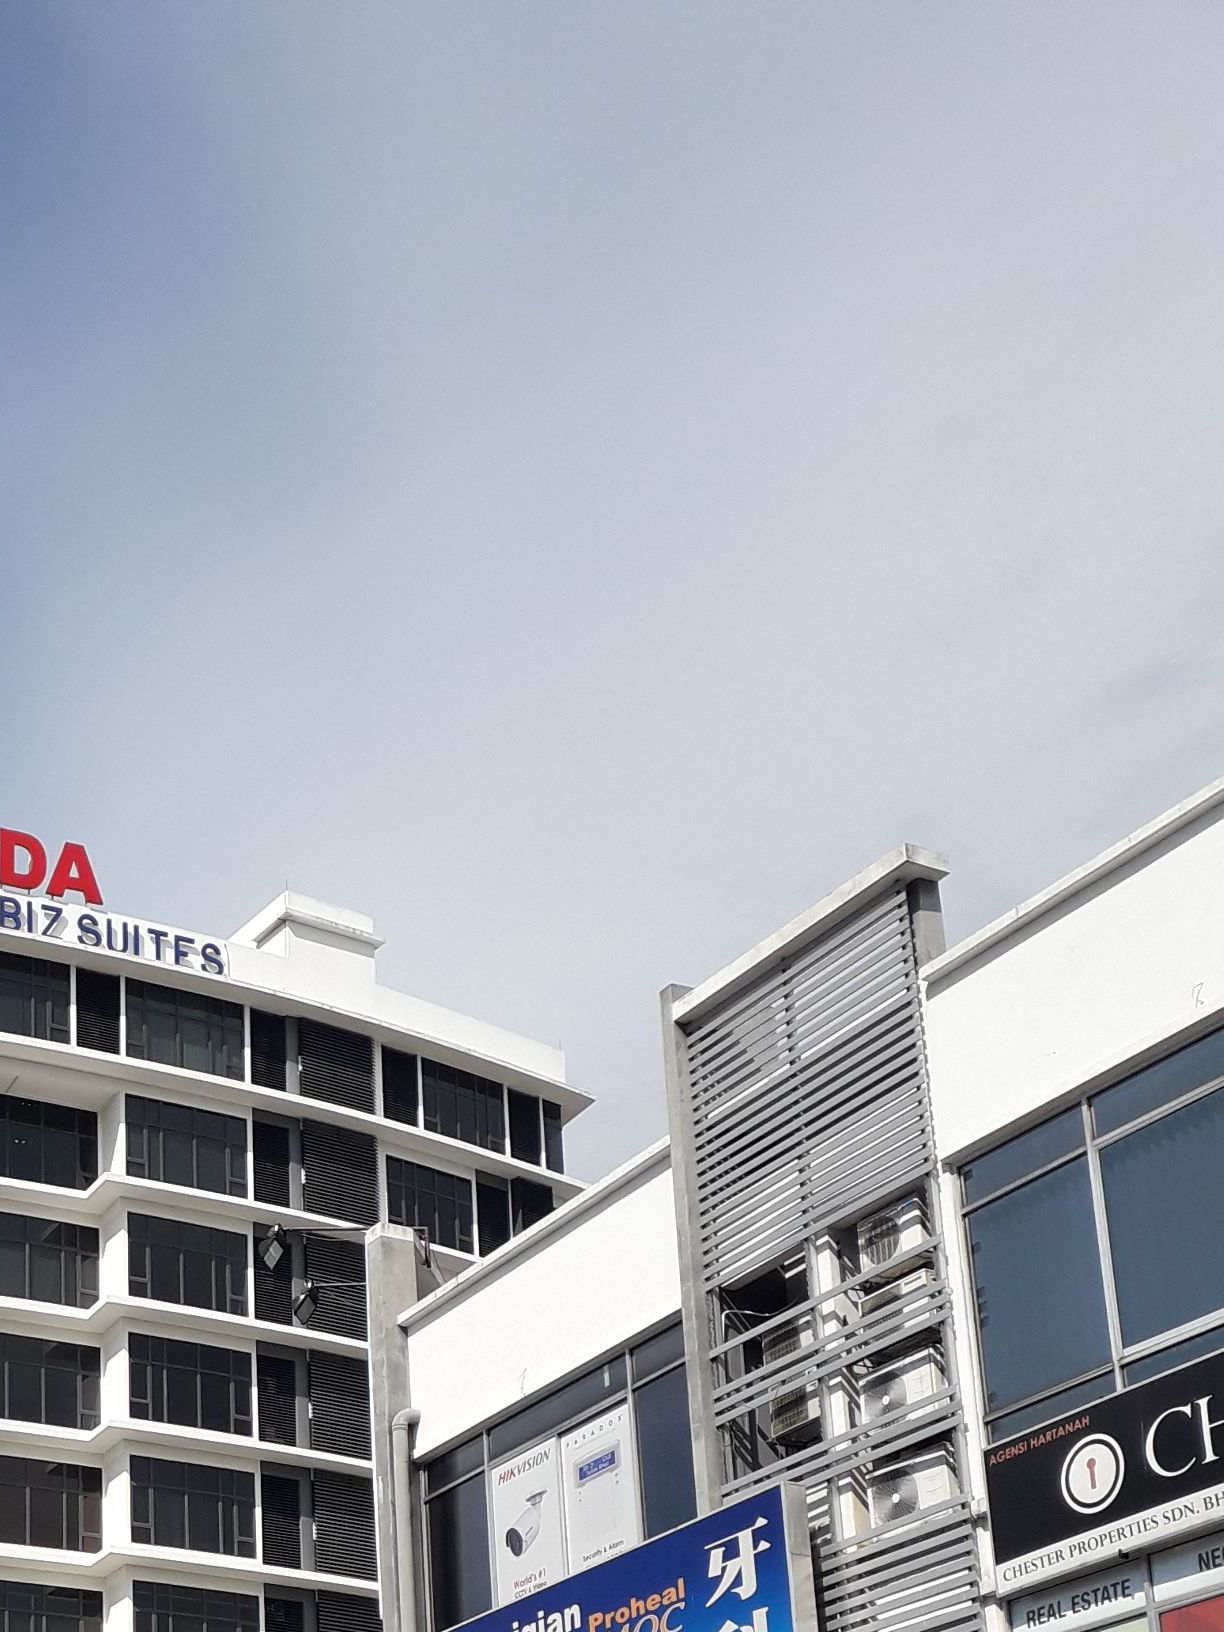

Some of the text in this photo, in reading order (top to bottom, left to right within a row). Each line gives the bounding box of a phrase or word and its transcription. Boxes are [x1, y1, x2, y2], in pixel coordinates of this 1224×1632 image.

[77, 912, 226, 977] SUITES
[566, 1415, 622, 1449] PARADOX
[988, 1415, 1090, 1466] AGENSI HARTANAH
[497, 1448, 552, 1487] HIKVISION
[582, 1547, 603, 1562] Security
[1002, 1549, 1066, 1583] CHESTER
[1068, 1514, 1160, 1558] PROPERTIES
[1162, 1500, 1201, 1526] SDN.
[513, 1573, 537, 1589] World's
[1026, 1602, 1067, 1629] REAL
